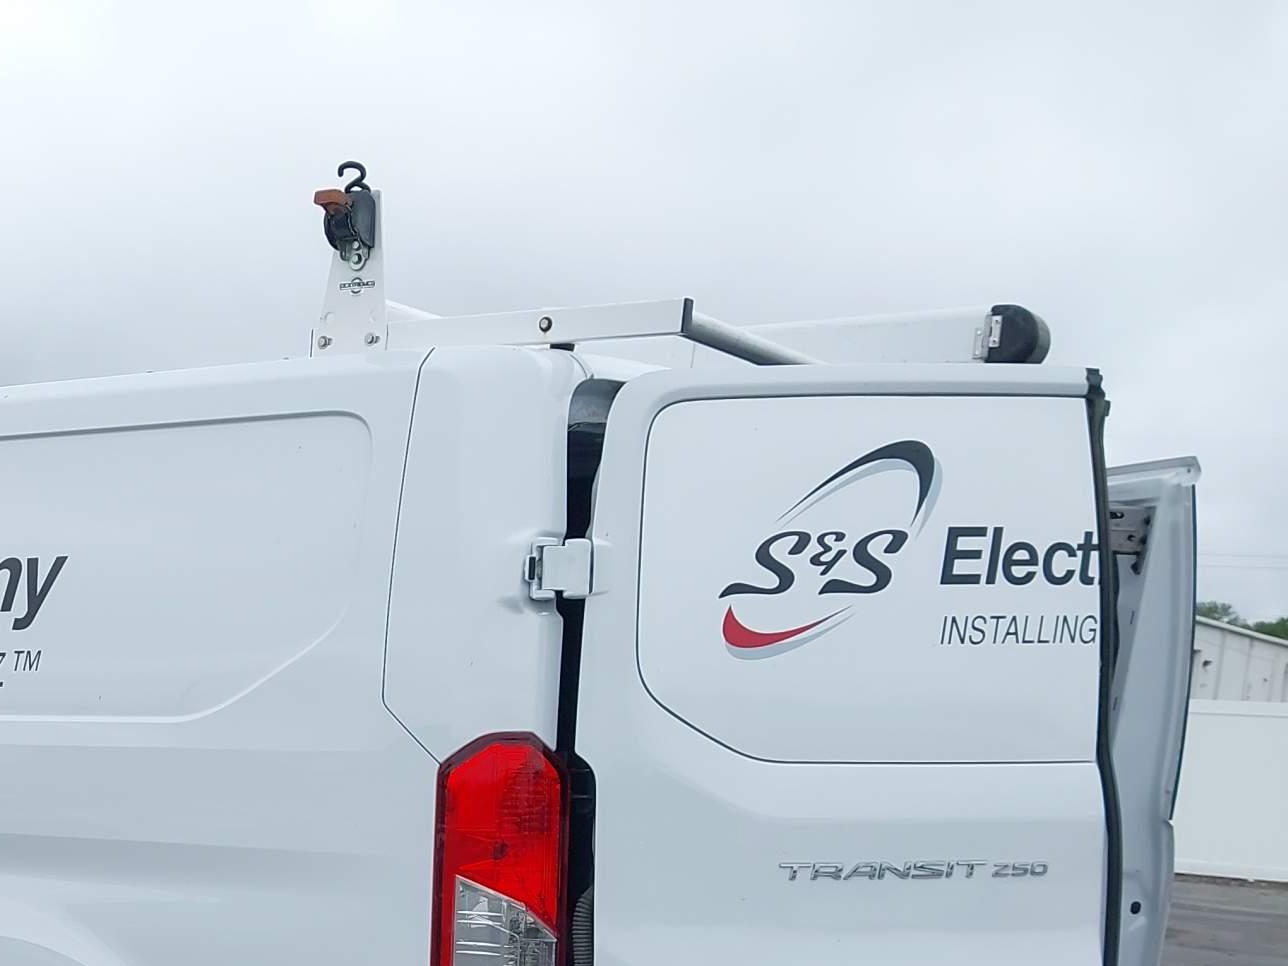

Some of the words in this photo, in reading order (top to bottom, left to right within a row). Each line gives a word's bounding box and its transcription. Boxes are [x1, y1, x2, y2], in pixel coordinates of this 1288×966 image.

[718, 530, 909, 599] S&S
[940, 615, 1098, 645] INSTALLING
[778, 860, 988, 881] TRANSIT
[991, 861, 1049, 878] 250
